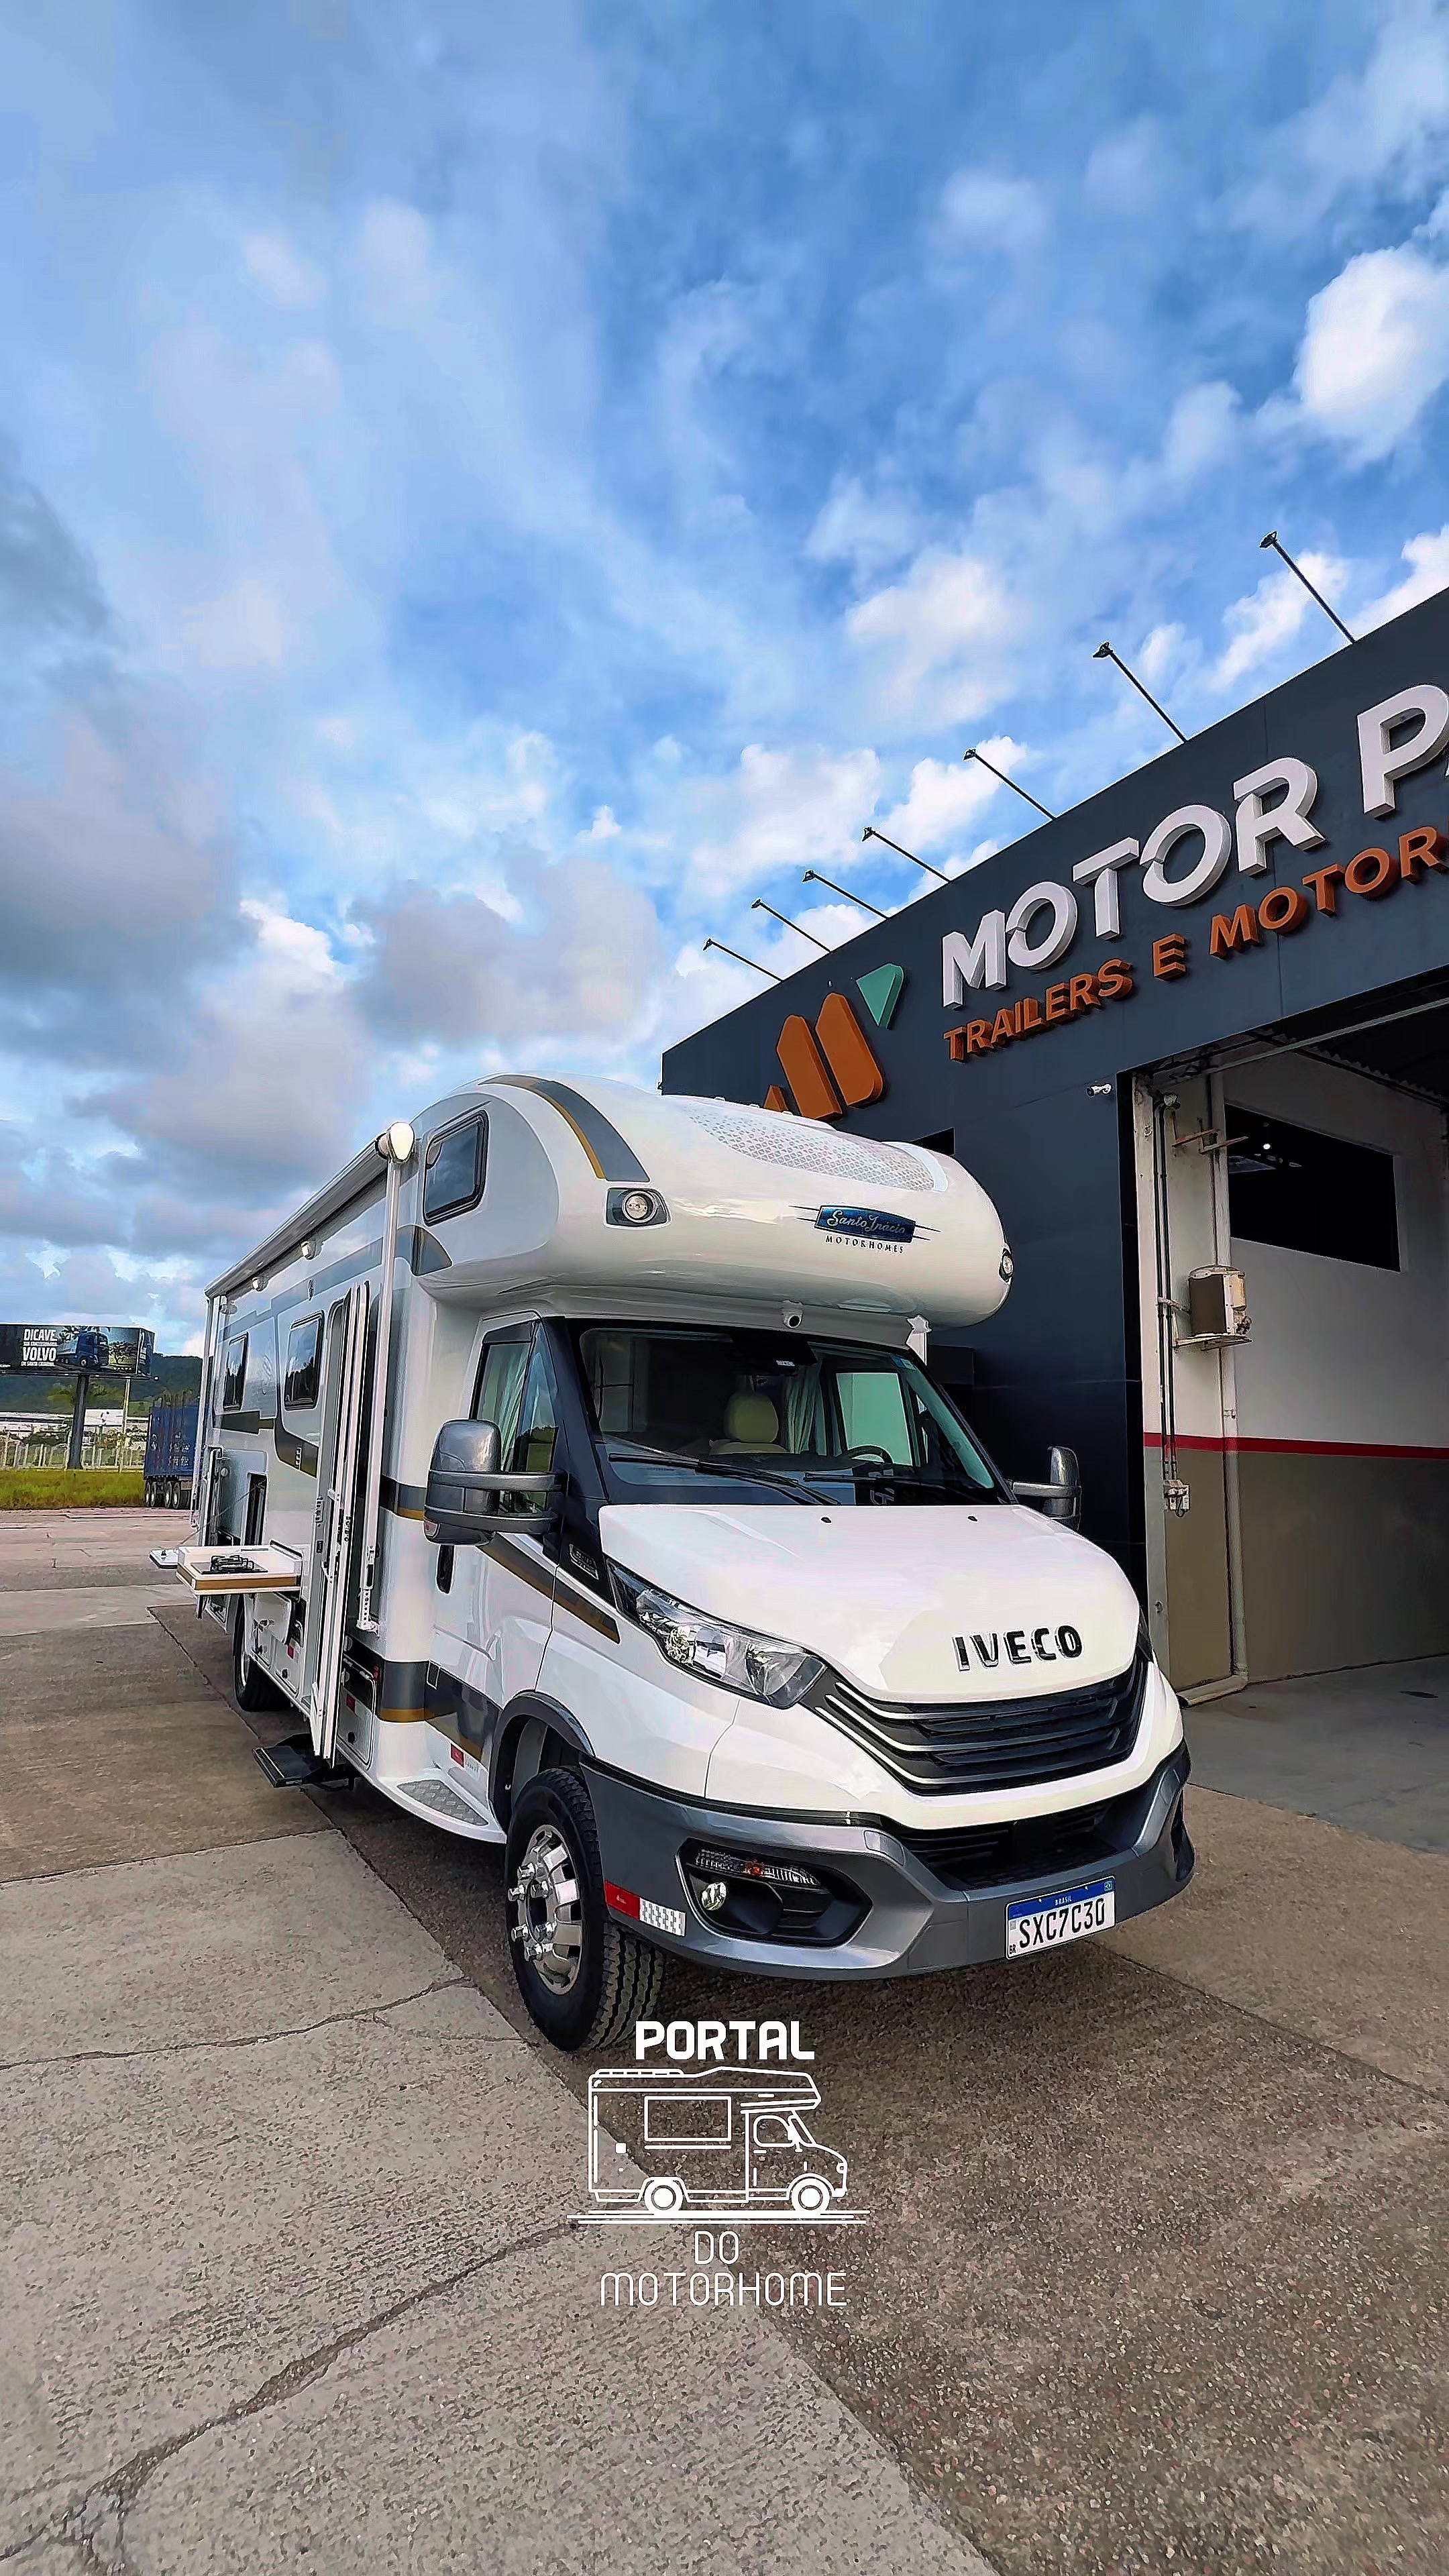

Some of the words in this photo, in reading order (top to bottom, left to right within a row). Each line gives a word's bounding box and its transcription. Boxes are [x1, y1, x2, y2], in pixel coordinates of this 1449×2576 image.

[942, 756, 1326, 1010] MOTOR
[1357, 684, 1449, 818] P
[943, 958, 1134, 1062] TRAILERS
[1152, 933, 1187, 981] E
[1210, 816, 1449, 959] MOTOR
[825, 1235, 904, 1254] MOTORHOMES
[22, 1346, 57, 1362] VOLVO
[23, 1328, 58, 1342] DICAVE
[951, 1625, 1083, 1672] IVECO
[1019, 1898, 1106, 1949] SXC7C30
